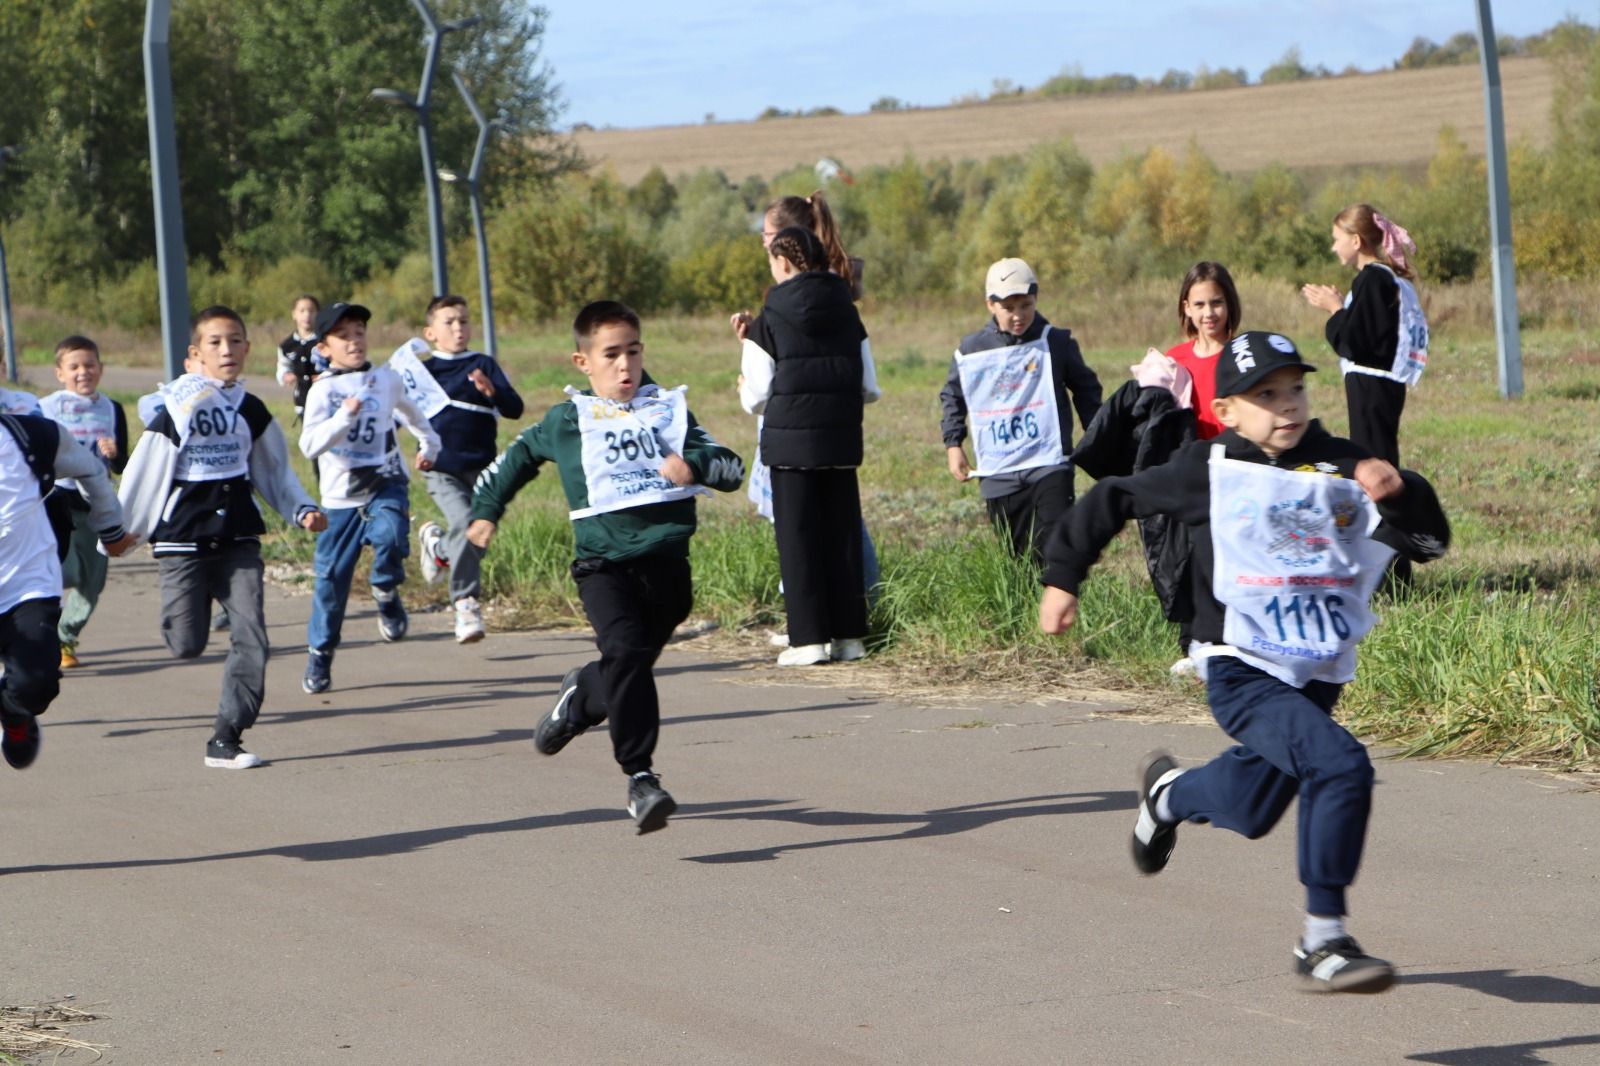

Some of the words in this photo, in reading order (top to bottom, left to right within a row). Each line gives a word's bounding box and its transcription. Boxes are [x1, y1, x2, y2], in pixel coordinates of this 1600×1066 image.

[1408, 325, 1430, 353] 18
[988, 412, 1039, 445] 1466
[1264, 594, 1351, 642] 1116
